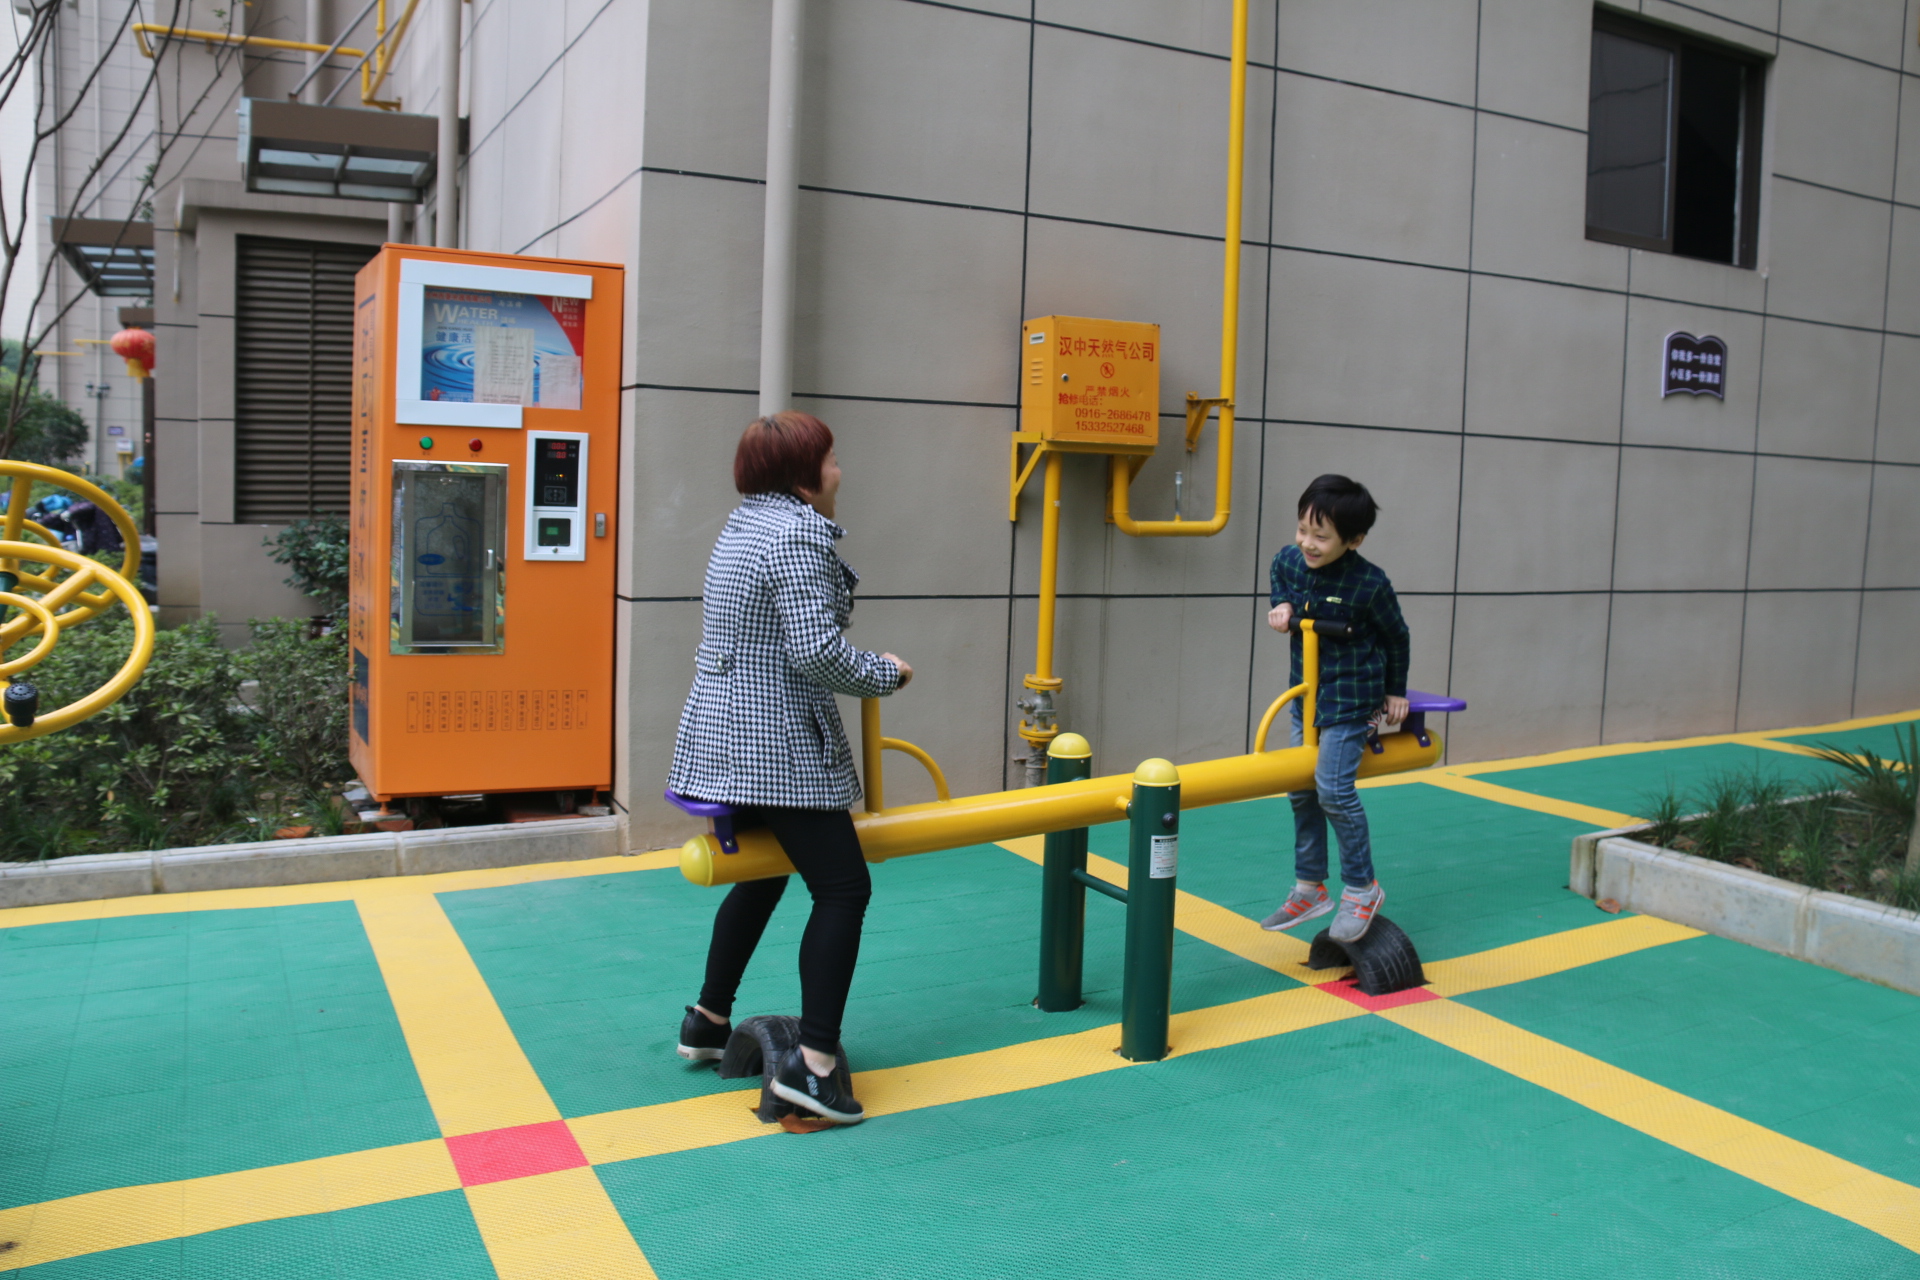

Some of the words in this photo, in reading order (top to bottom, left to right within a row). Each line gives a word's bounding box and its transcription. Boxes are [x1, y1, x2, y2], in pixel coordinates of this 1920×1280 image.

[552, 296, 579, 313] NEW
[433, 303, 498, 324] WATER
[436, 331, 472, 344] 健康活
[1059, 336, 1155, 362] 汉中天然气公司
[1084, 385, 1131, 398] 严禁烟火
[1075, 407, 1151, 421] 0916-2686478
[1075, 421, 1145, 434] 15332527468
